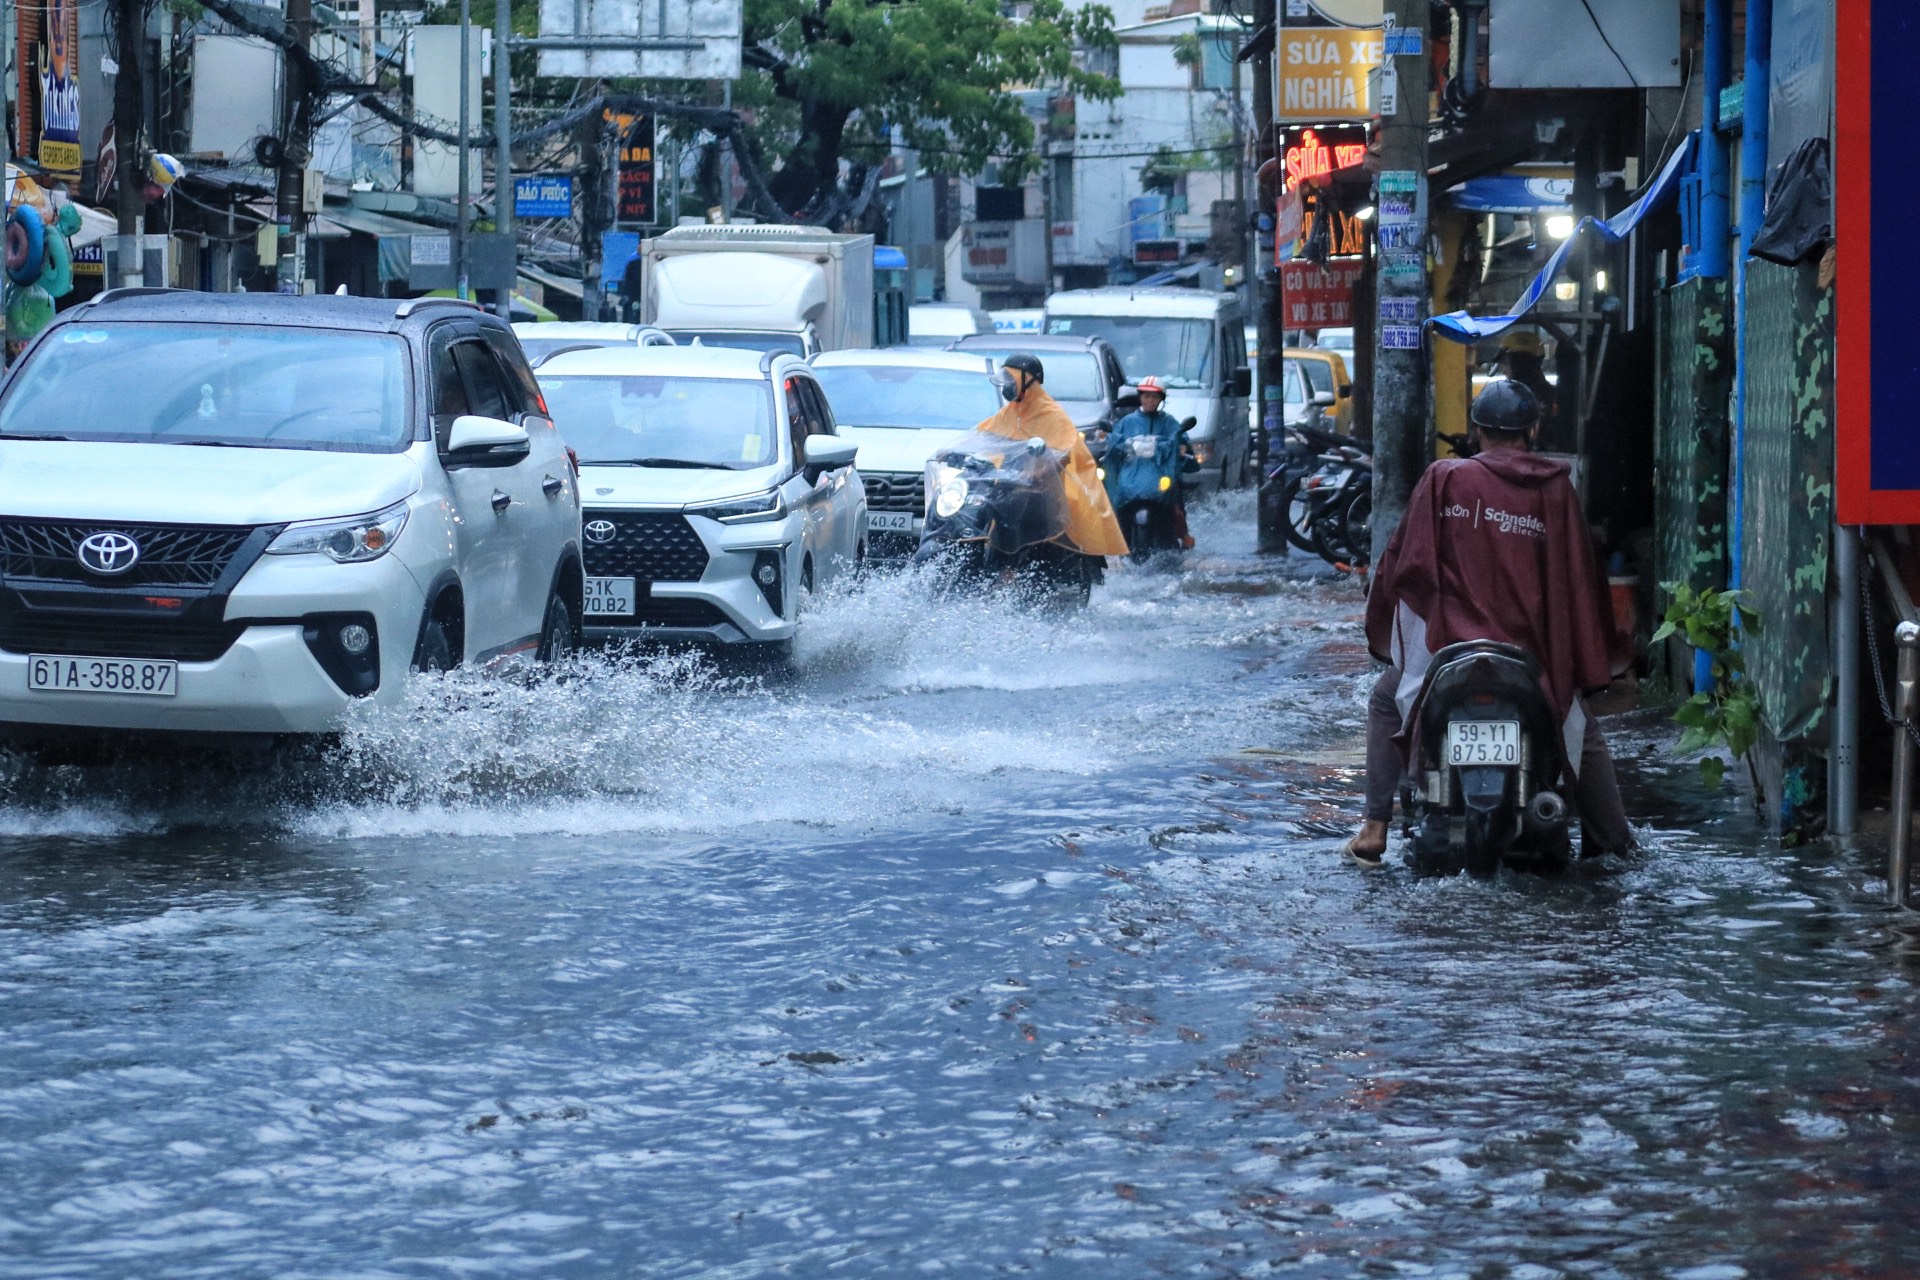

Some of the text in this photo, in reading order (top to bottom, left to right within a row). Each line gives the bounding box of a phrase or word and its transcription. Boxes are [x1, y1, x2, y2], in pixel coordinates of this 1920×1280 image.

[1287, 35, 1341, 65] SỬA
[1350, 41, 1383, 64] XE
[1284, 70, 1357, 110] NGHĨA
[39, 74, 79, 131] VIKINGS
[43, 144, 63, 165] ESPORTS
[541, 183, 569, 201] PHÚC
[74, 246, 103, 260] IKI
[1311, 302, 1327, 321] XE
[1329, 301, 1350, 320] TAY
[870, 515, 906, 528] 40.42
[1484, 507, 1546, 533] Schneide
[583, 597, 627, 613] 70.82
[34, 659, 172, 692] 61A-358.87
[1459, 724, 1507, 742] 59-Y1
[1453, 743, 1515, 762] 875.20
